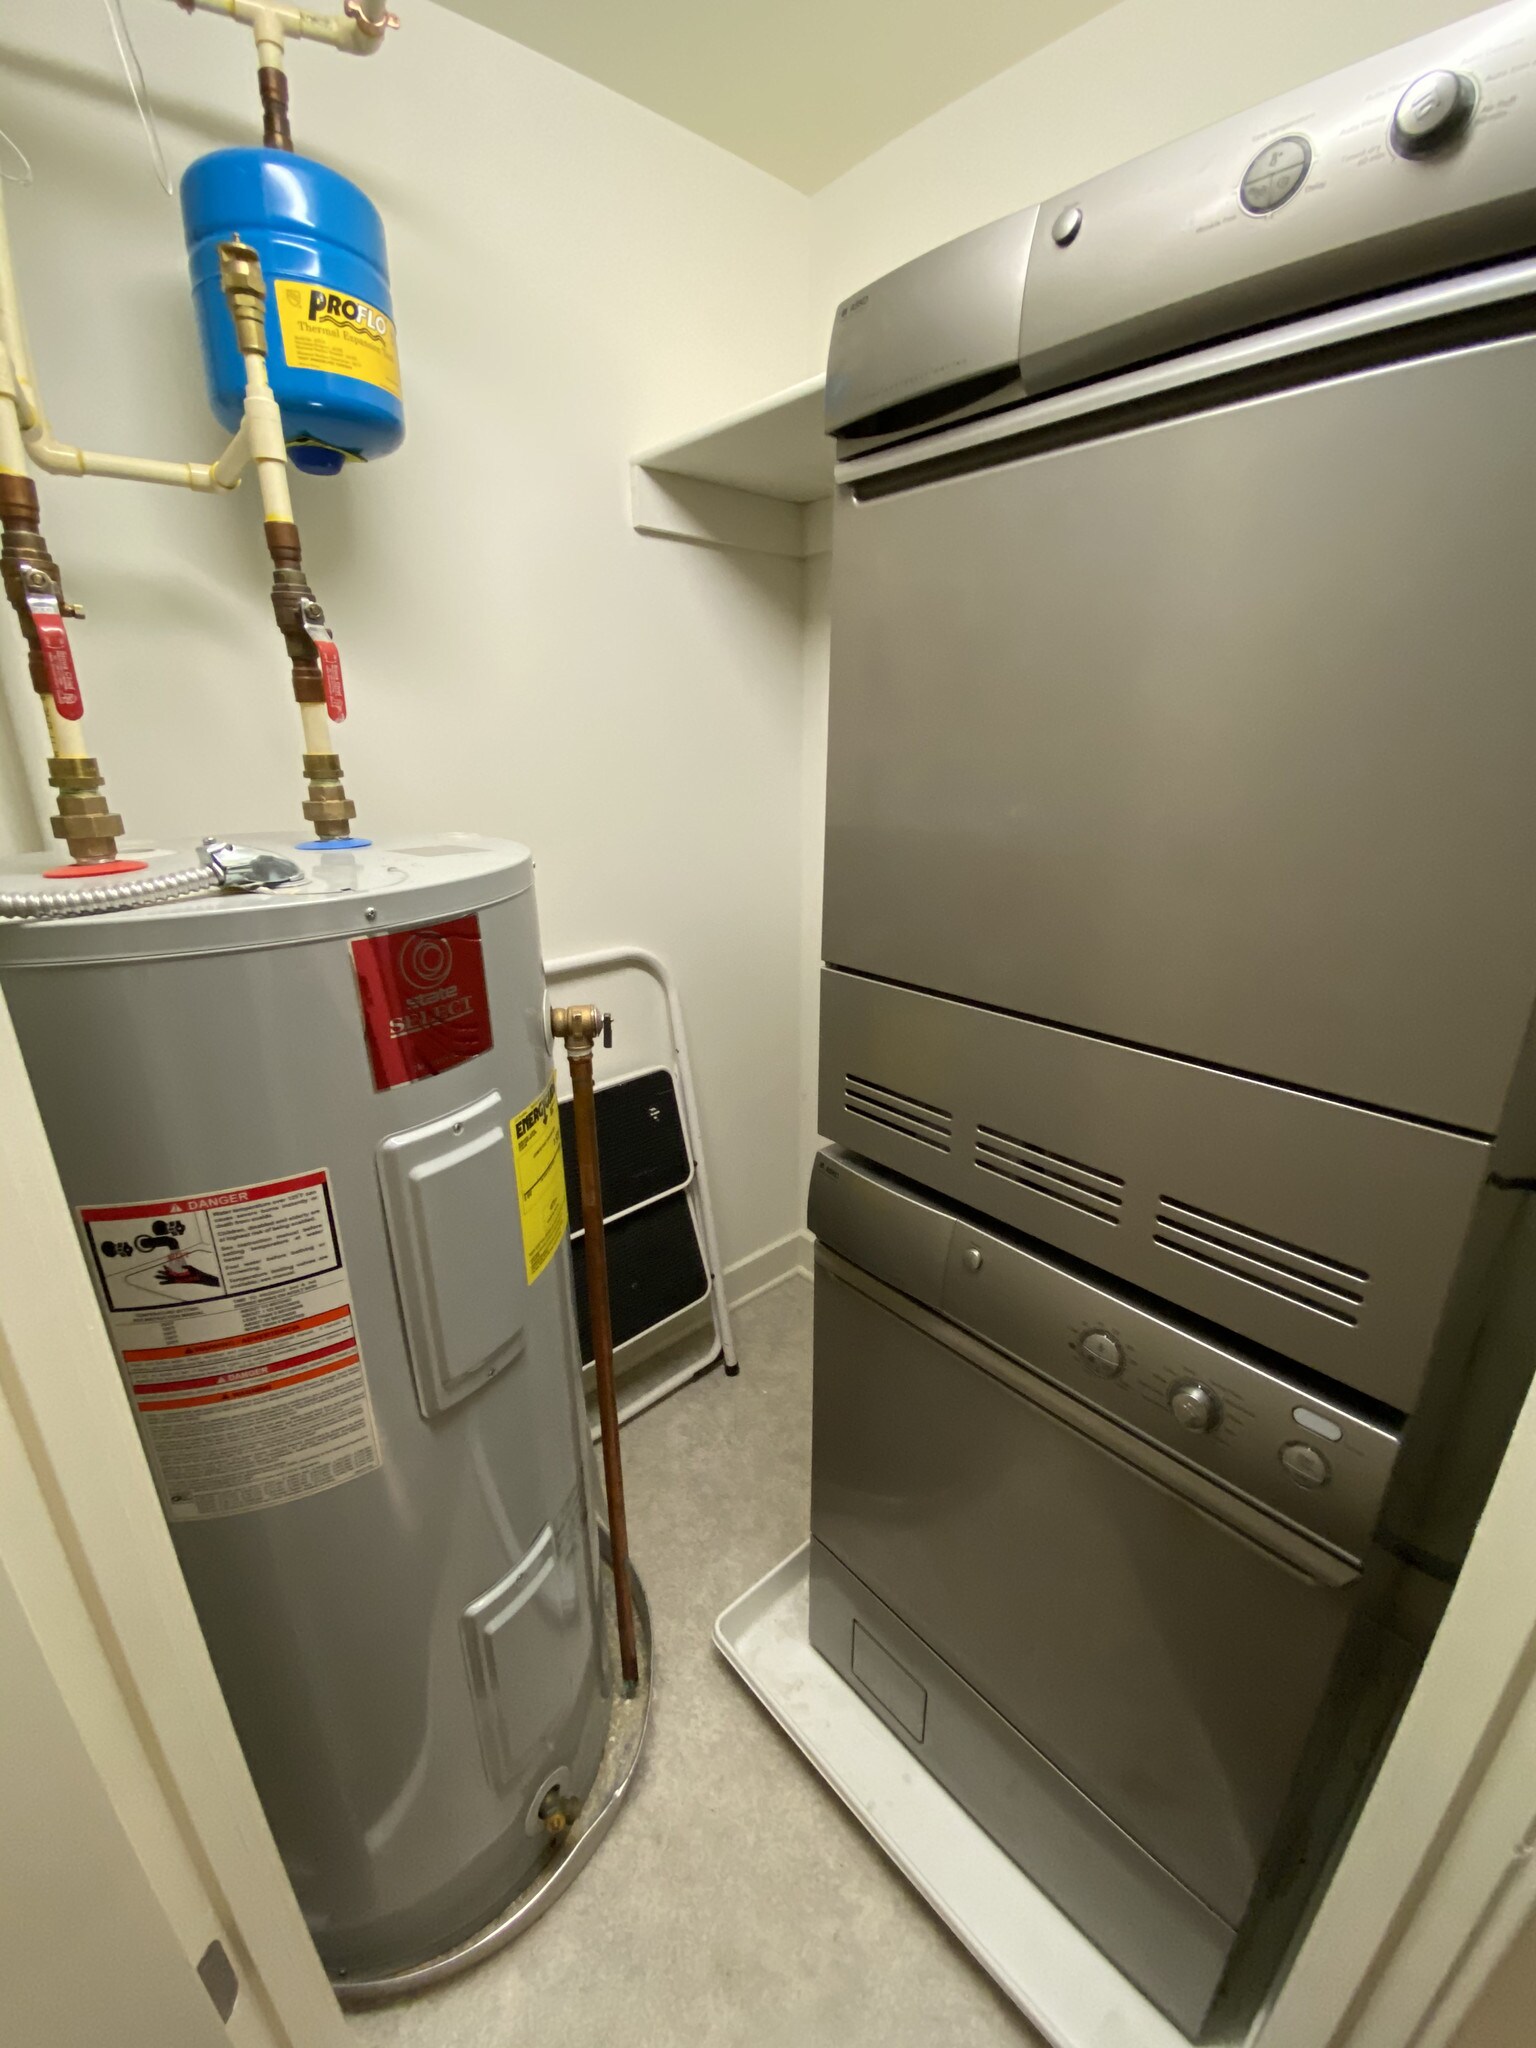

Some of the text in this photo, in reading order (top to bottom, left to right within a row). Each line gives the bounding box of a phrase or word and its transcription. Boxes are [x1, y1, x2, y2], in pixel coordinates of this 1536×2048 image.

[308, 290, 386, 335] PROFLO
[297, 321, 340, 337] Thermal
[389, 996, 474, 1034] SELECT
[188, 1191, 249, 1211] DANGER
[227, 1365, 269, 1382] DANGER
